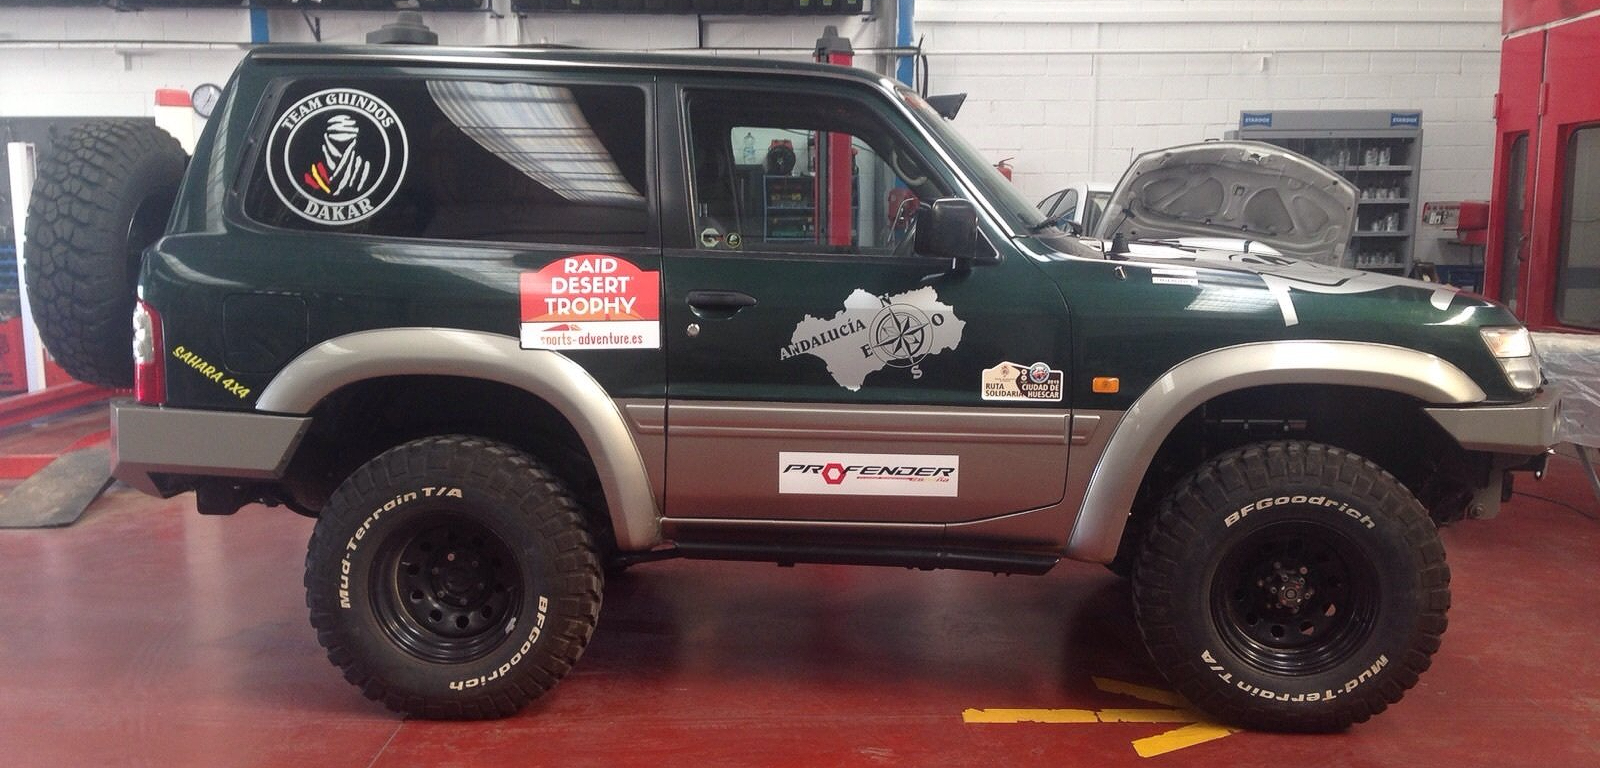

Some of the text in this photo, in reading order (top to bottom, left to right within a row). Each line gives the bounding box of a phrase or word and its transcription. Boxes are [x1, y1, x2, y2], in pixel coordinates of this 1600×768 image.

[281, 93, 394, 131] TEAM GUINDOS
[304, 198, 374, 221] DAKAR
[564, 258, 618, 274] RAID
[551, 276, 630, 295] DESERT
[544, 297, 636, 316] TROPHY
[878, 293, 892, 308] N
[931, 313, 945, 327] O
[779, 318, 866, 361] ANDALUCÍA
[860, 344, 874, 359] E
[172, 345, 224, 383] SAHARA
[911, 365, 923, 380] S
[1022, 383, 1060, 392] CIUDAD DE
[783, 462, 955, 485] PROFENDER
[1223, 495, 1376, 530] BFGoodrich
[338, 486, 463, 609] Mud-Terrain T/A
[450, 595, 548, 691] BFGoodrich
[1201, 650, 1389, 702] Mud-Terrain T/A
